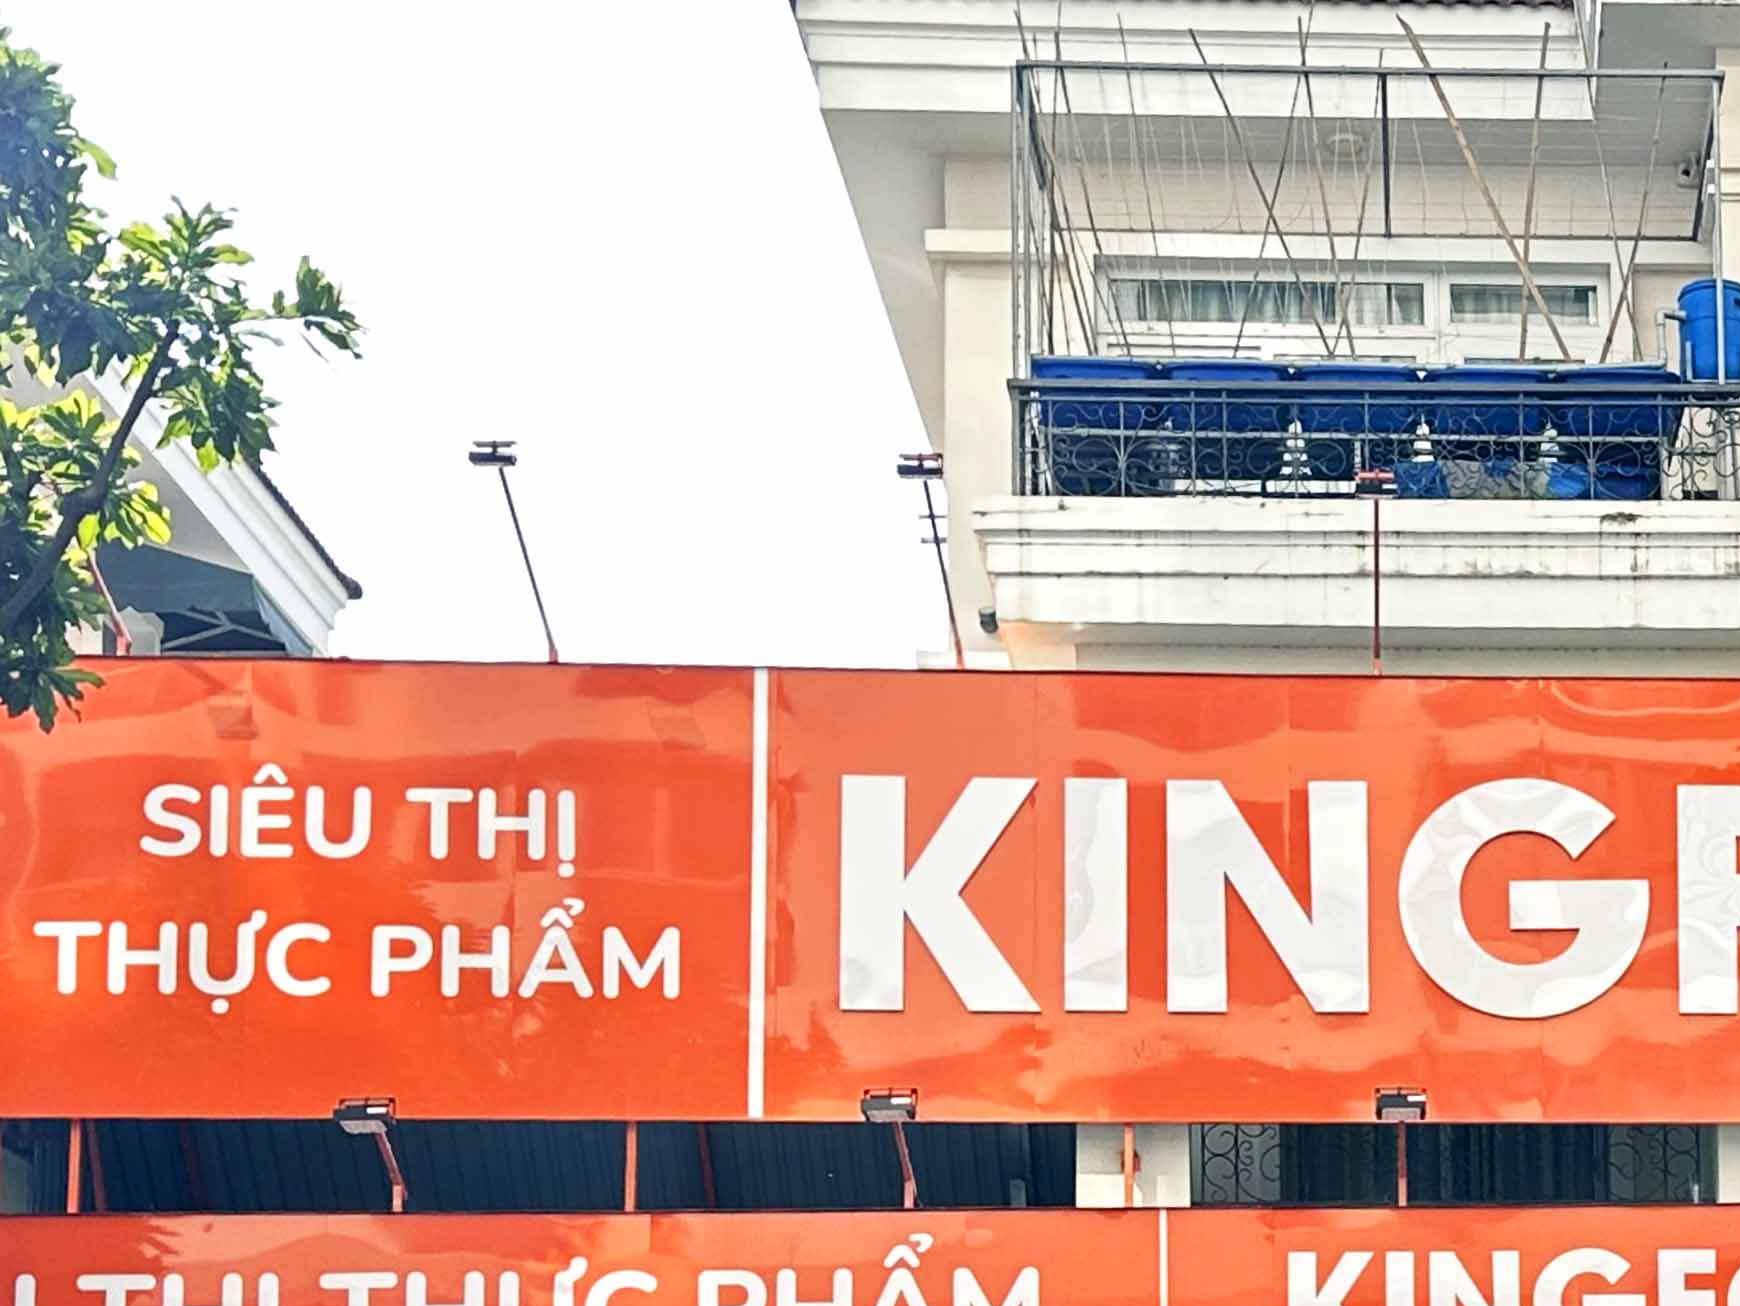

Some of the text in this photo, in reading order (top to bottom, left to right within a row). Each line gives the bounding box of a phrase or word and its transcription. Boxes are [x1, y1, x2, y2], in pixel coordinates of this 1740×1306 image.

[139, 763, 577, 878] SIÊU THỊ
[34, 897, 681, 1015] THỰC PHẨM
